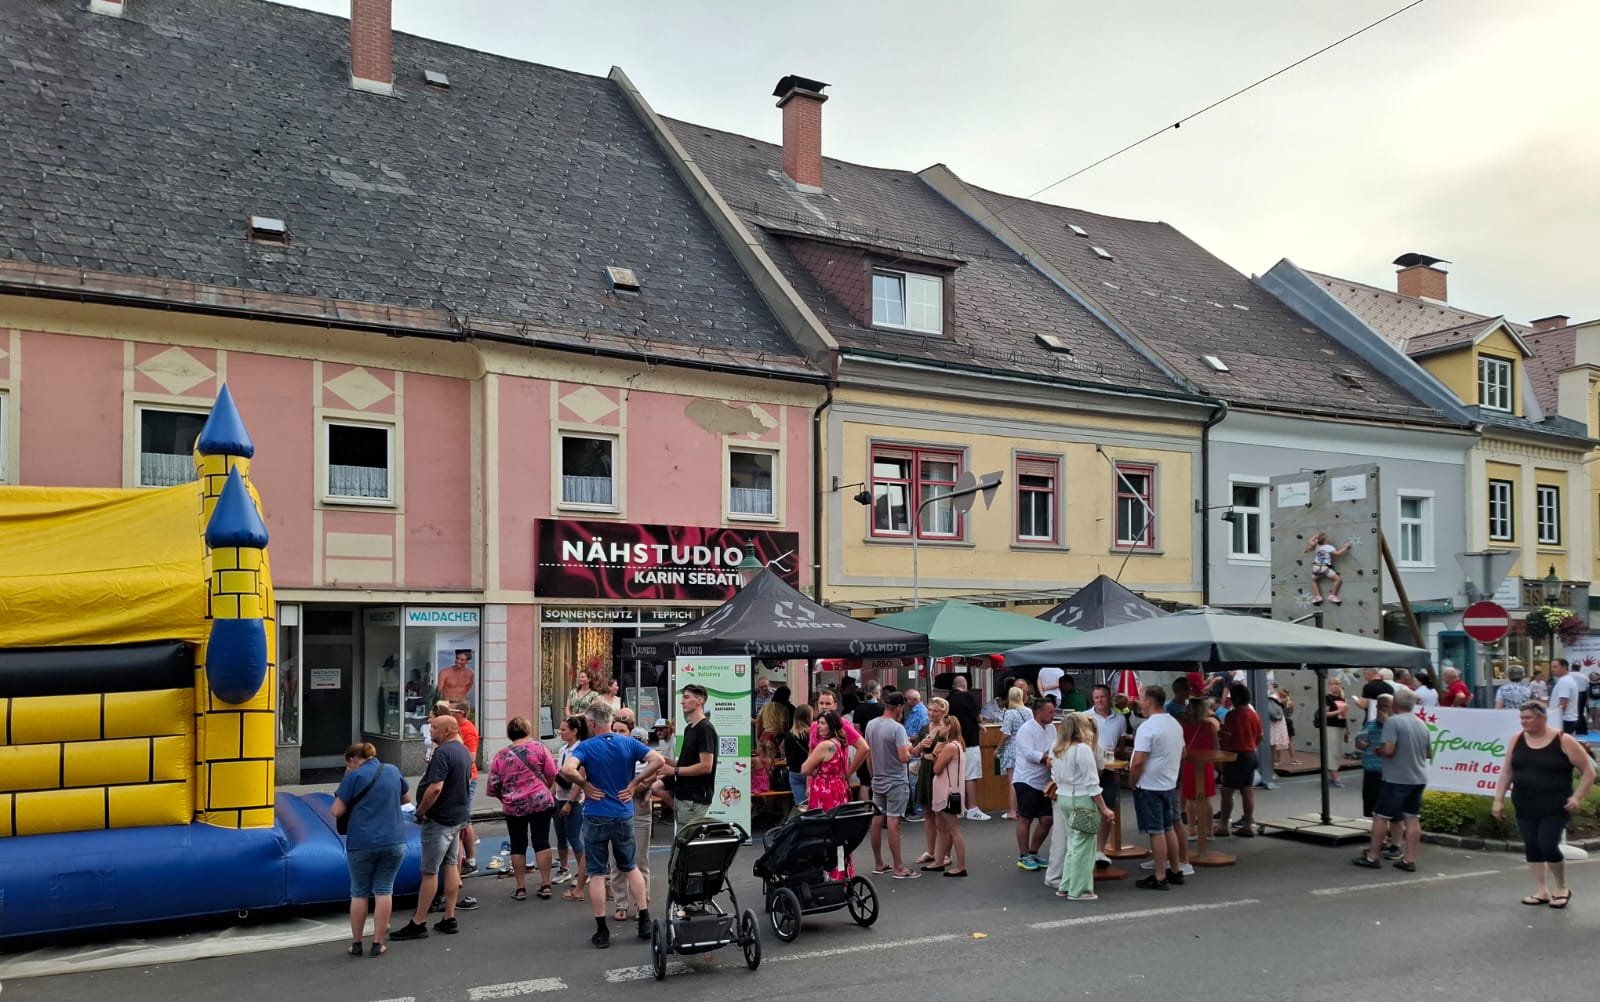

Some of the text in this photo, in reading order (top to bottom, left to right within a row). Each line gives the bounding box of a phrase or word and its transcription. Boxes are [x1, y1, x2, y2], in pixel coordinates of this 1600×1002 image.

[562, 536, 744, 567] NÄHSTUDIO
[634, 571, 741, 586] KARIN SEBATI
[408, 611, 478, 622] WAIDACHER
[545, 609, 692, 619] SONNENSCHUTZ TEPPICH
[774, 620, 847, 629] XLMOTO
[762, 643, 809, 653] XLMOTO
[866, 643, 907, 652] XLMOTO
[1430, 729, 1506, 766] freunde
[1482, 761, 1501, 774] de
[1476, 779, 1495, 790] au
